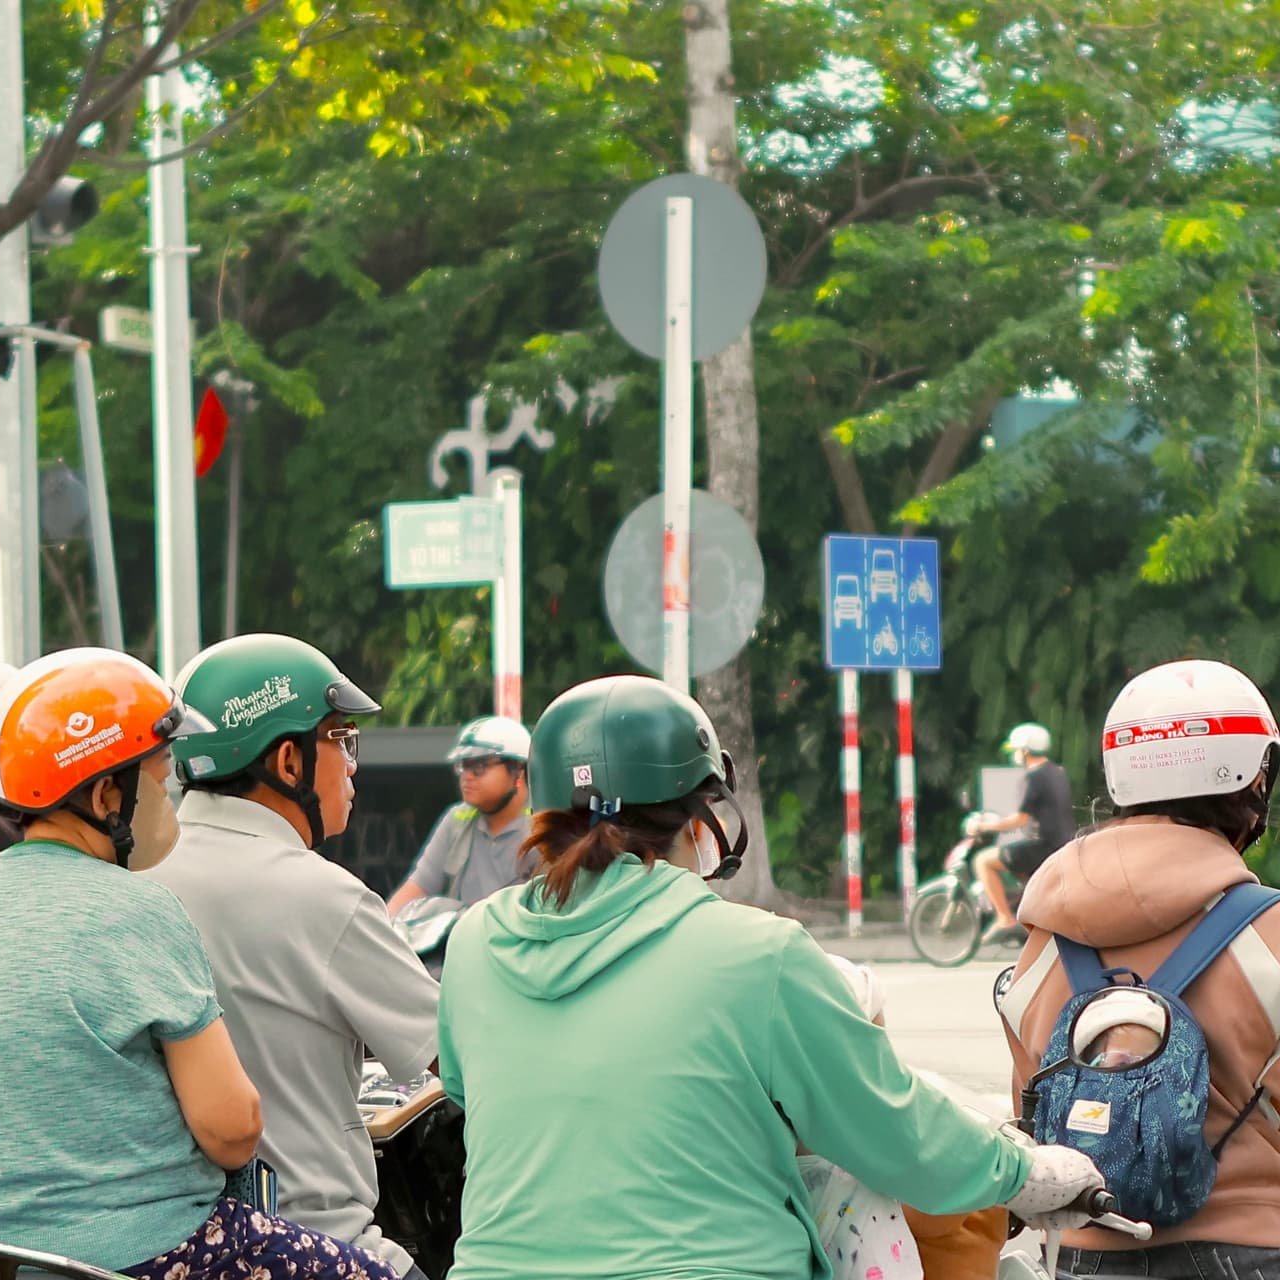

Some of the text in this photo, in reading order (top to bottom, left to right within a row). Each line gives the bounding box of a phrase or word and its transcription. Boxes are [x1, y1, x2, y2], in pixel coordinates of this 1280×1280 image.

[221, 694, 280, 728] Linguistic
[224, 680, 275, 712] Magical
[1141, 722, 1174, 731] HONDA
